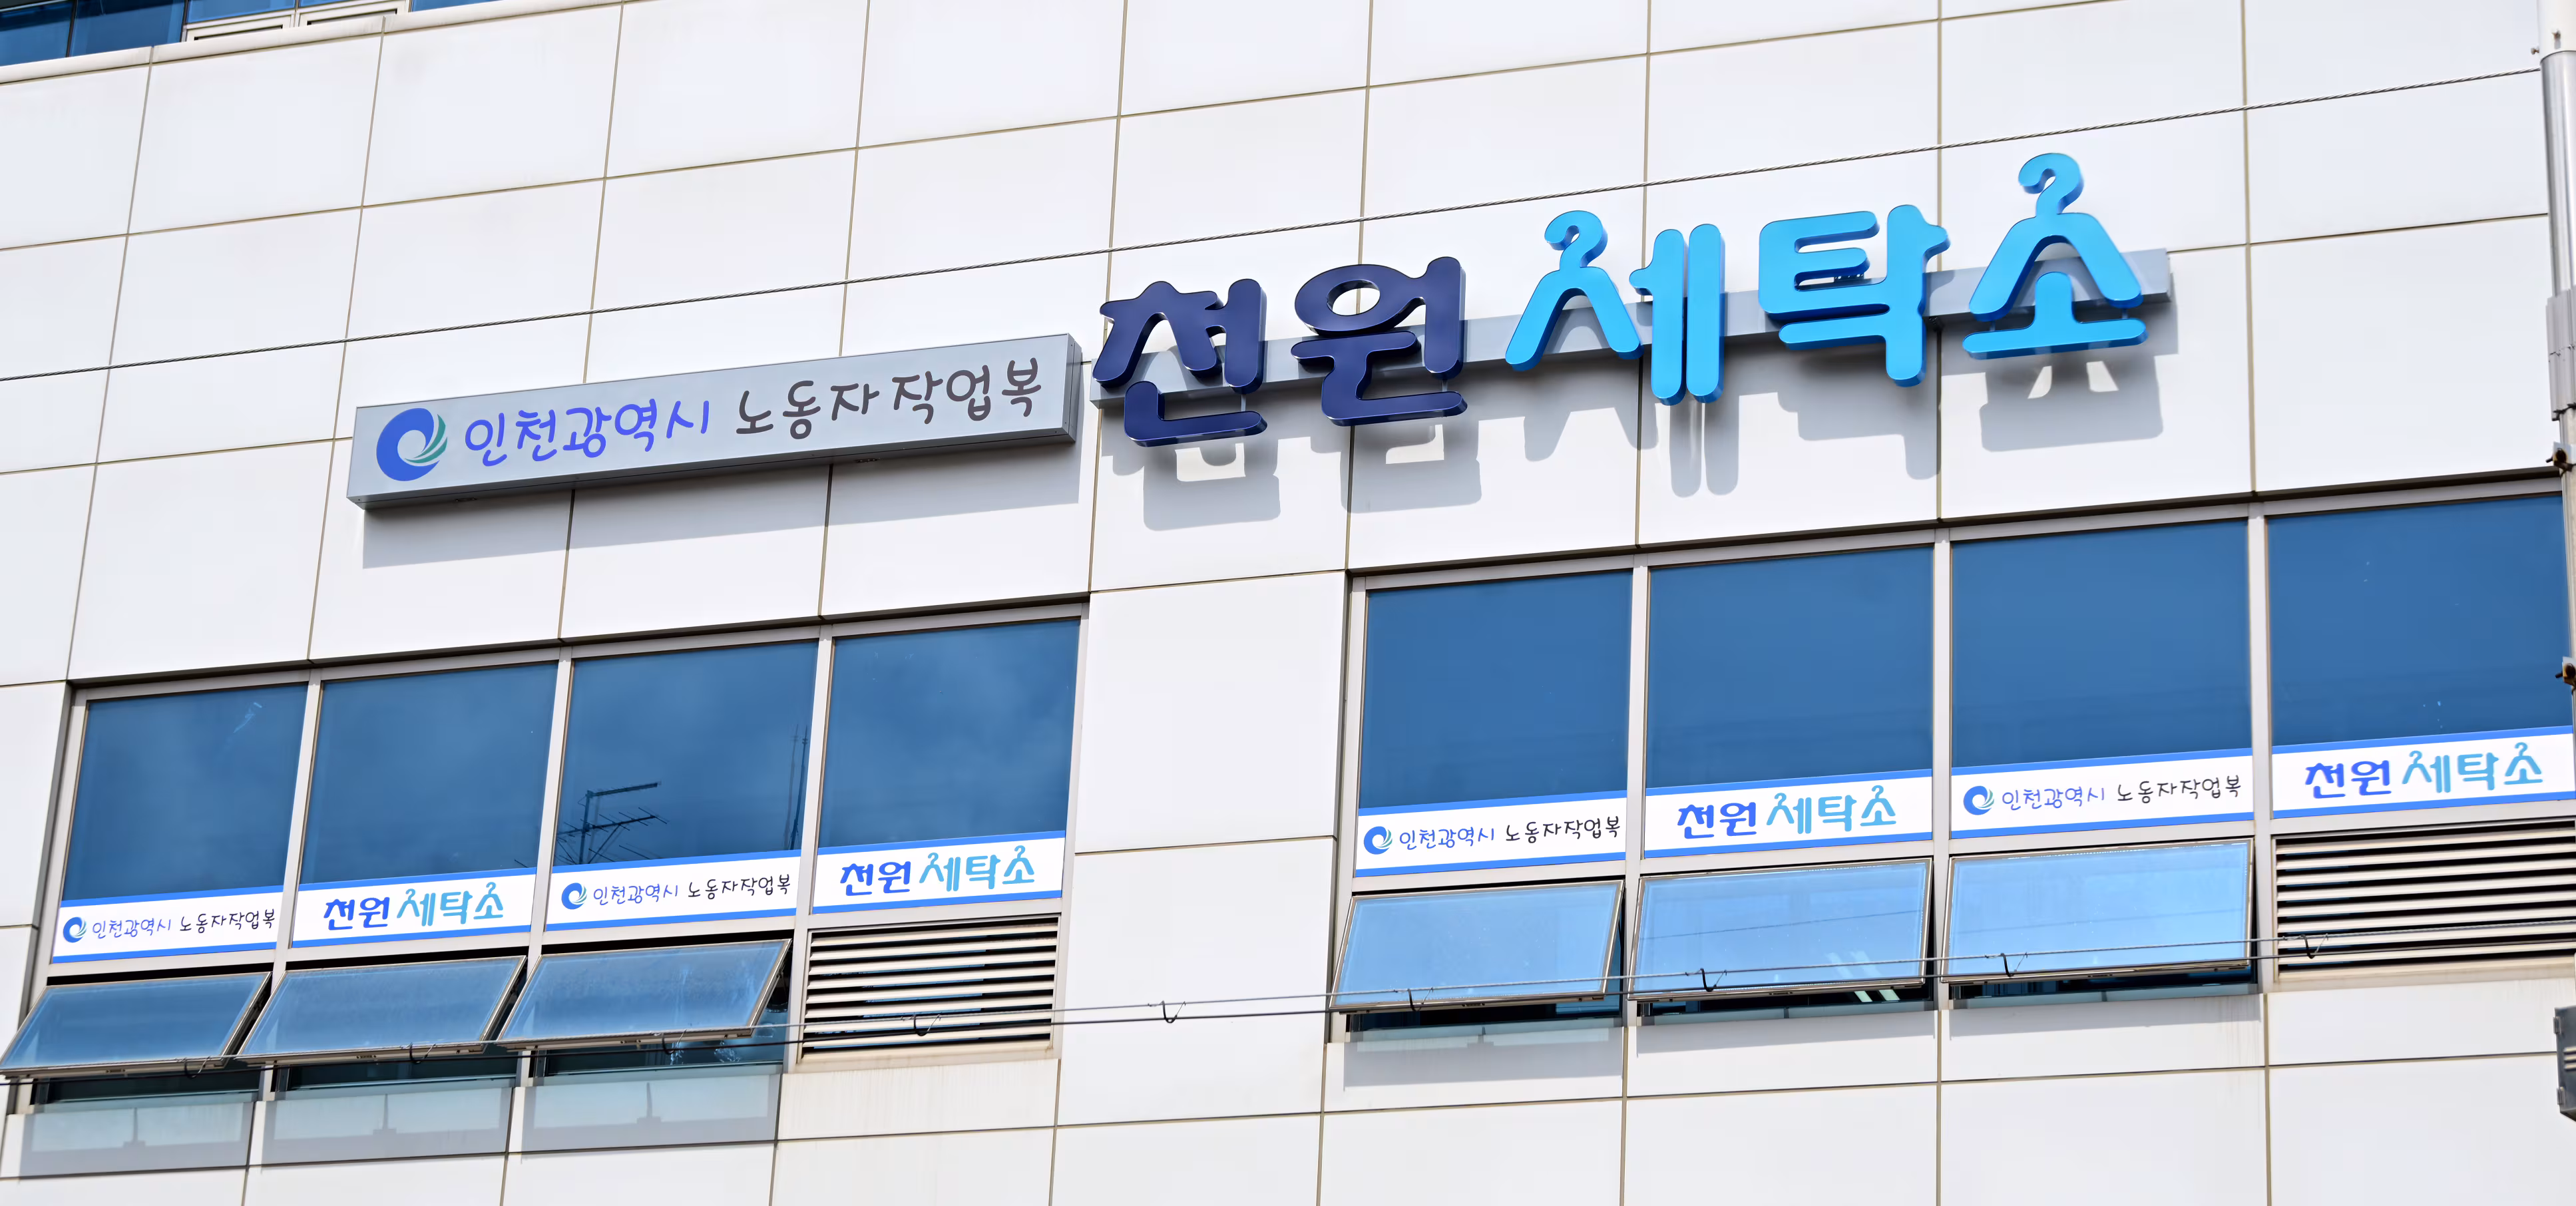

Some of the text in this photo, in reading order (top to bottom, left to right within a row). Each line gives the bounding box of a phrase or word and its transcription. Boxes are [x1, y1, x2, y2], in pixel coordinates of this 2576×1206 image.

[1092, 152, 2150, 448] 천원 세탁소
[464, 398, 710, 467] 인천광역시
[2304, 741, 2543, 799] 천원 세탁소
[1677, 784, 1898, 839] 천원 세탁소
[2002, 786, 2105, 811] 인천광역시
[1399, 826, 1496, 851] 인천광역시
[593, 883, 678, 906] 인천광역시
[839, 845, 1036, 897] 천원 세탁소
[92, 917, 171, 939] 인천광역시
[323, 881, 504, 932] 천원 세탁소
